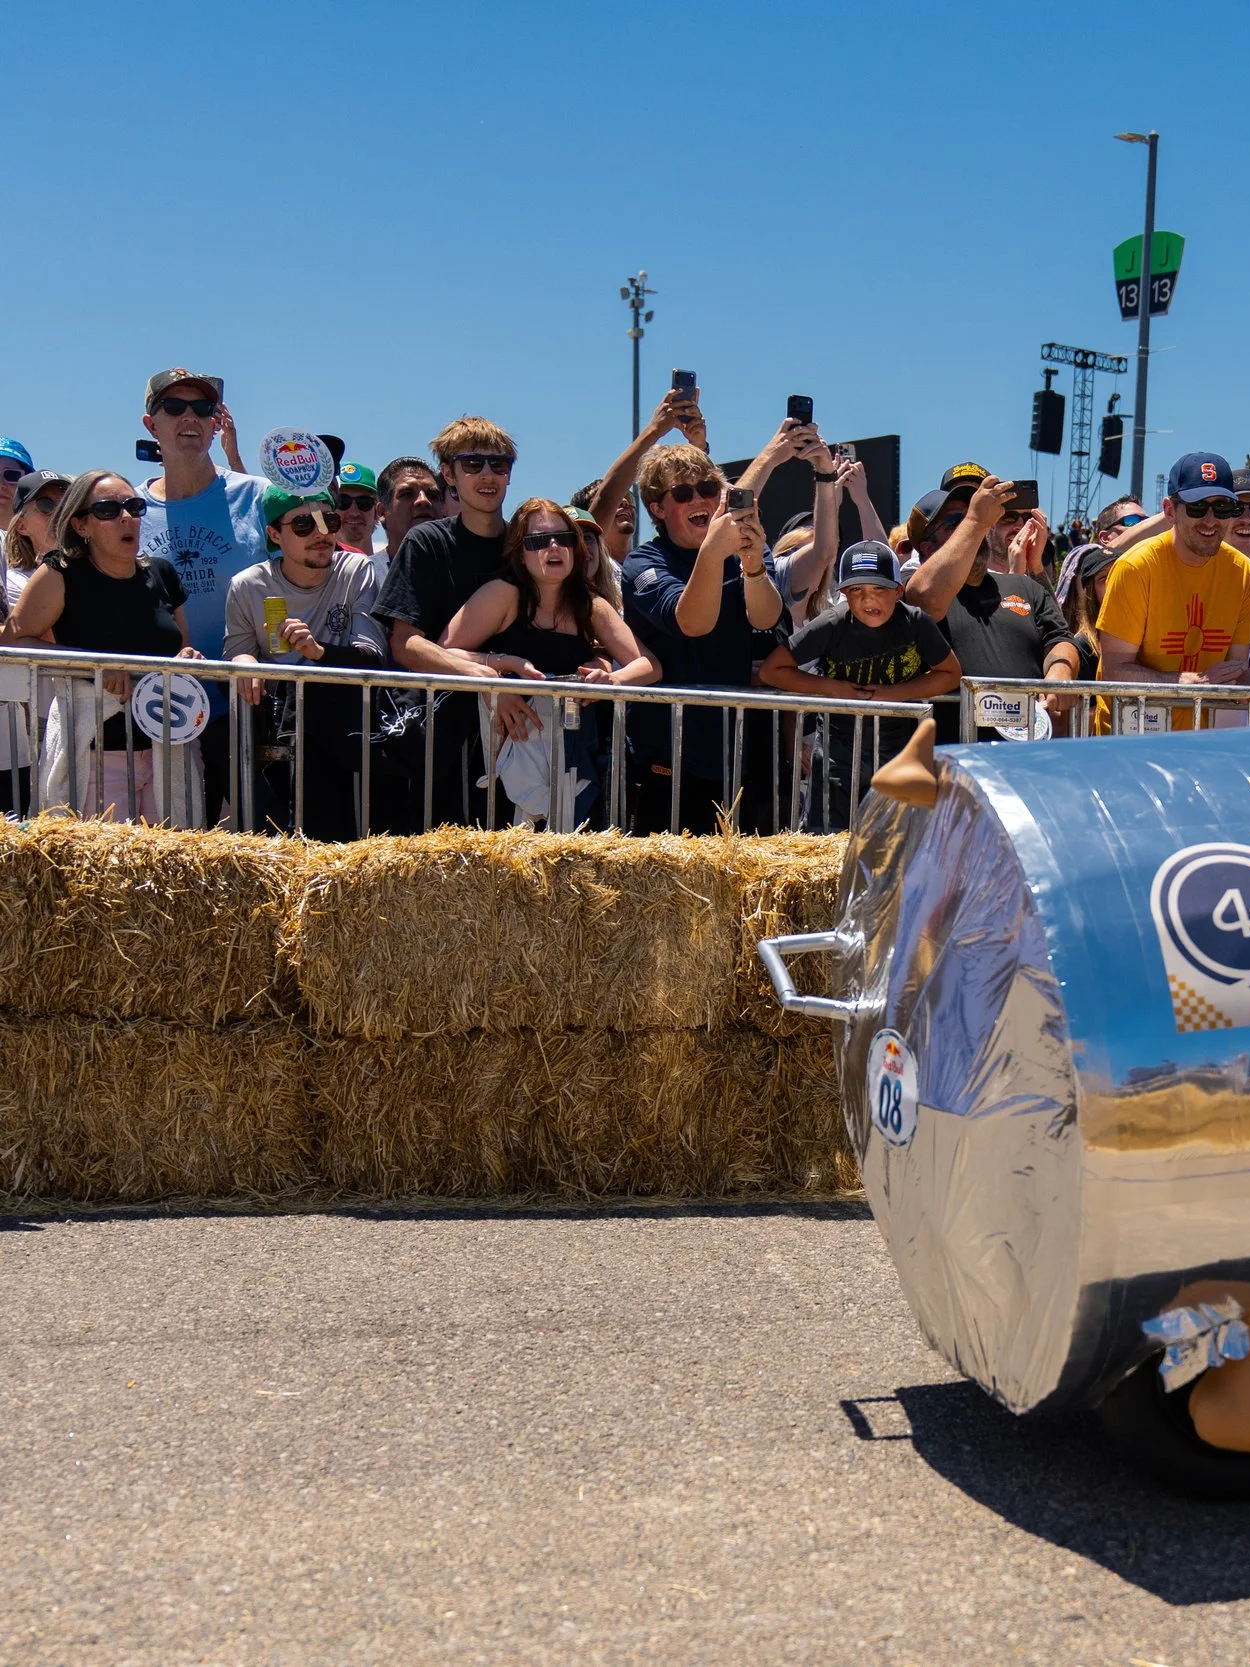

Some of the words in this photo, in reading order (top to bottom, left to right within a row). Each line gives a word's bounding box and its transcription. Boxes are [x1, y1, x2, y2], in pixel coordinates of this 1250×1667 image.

[1125, 250, 1136, 273] J
[1159, 243, 1169, 267] J
[1119, 283, 1138, 308] 13
[1152, 278, 1171, 303] 13
[284, 465, 316, 475] SOAPBOX
[294, 473, 312, 481] RACE
[1201, 463, 1217, 481] S
[145, 526, 180, 555] ENICE
[189, 525, 232, 554] BEACH
[161, 539, 206, 554] ORIGINAL
[984, 700, 1021, 710] United
[1133, 711, 1158, 720] Uited
[879, 1074, 902, 1135] 08
